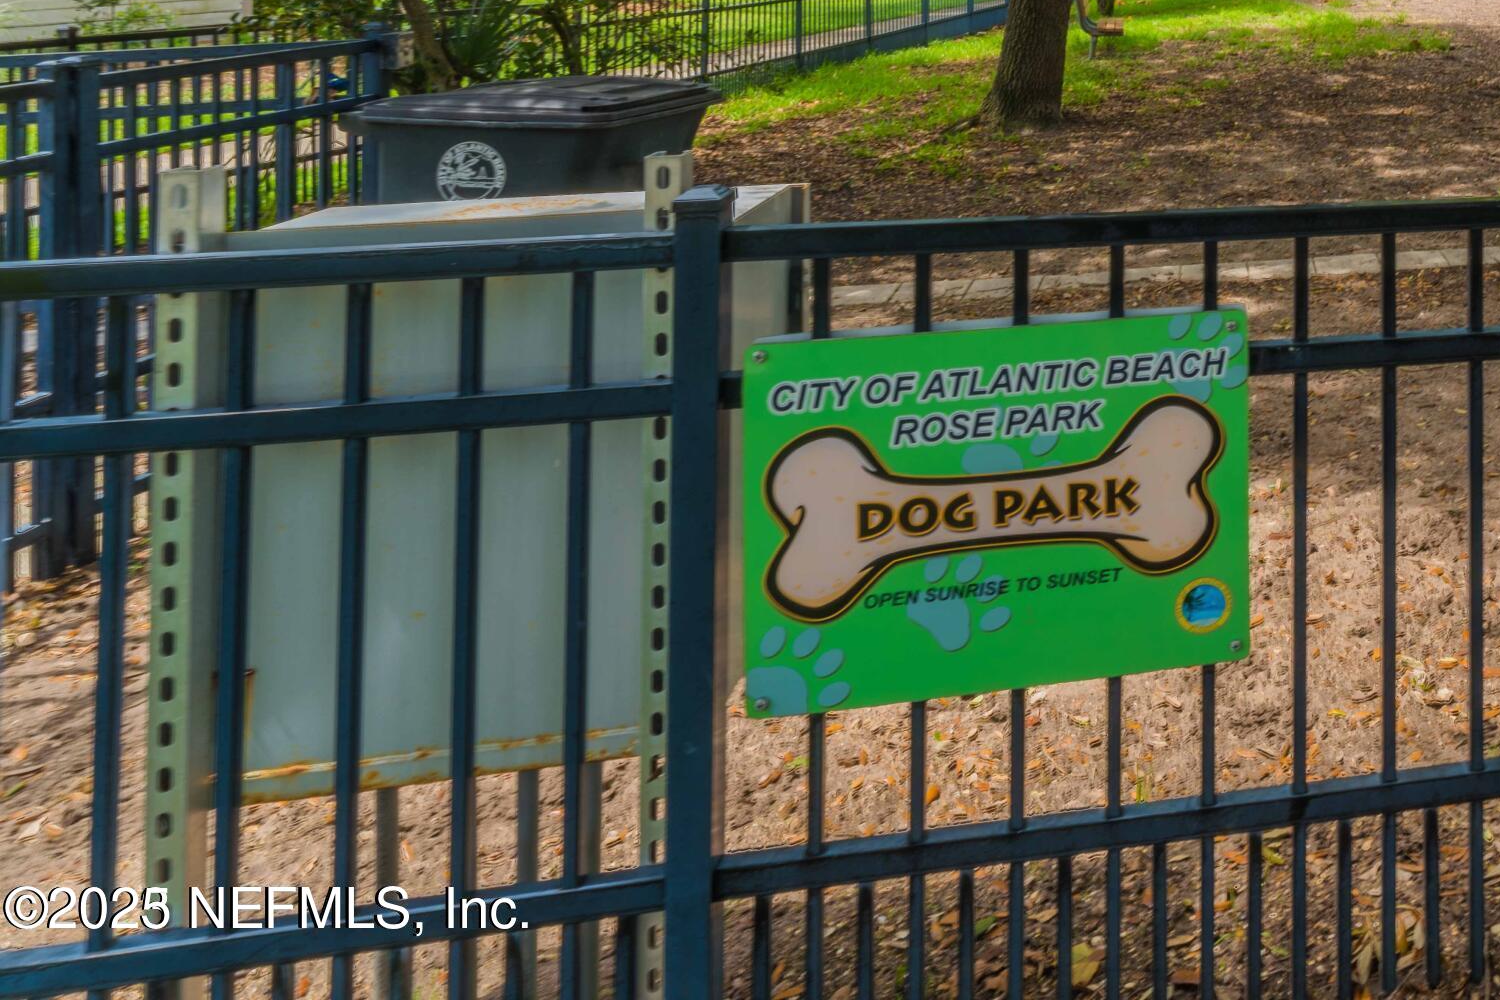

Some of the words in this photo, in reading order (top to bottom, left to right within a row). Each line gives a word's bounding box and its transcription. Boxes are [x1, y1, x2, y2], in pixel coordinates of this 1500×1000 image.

[770, 377, 858, 413] CITY
[863, 374, 918, 405] OF
[919, 360, 1099, 401] ATLANTIC
[1104, 349, 1228, 386] BEACH
[892, 409, 997, 447] ROSE
[1003, 400, 1105, 436] PARK
[856, 492, 978, 542] DOG
[992, 476, 1141, 529] PARK
[863, 590, 919, 609] OPEN
[923, 579, 1010, 602] SUNRISE
[1016, 575, 1042, 593] TO
[1045, 567, 1124, 589] SUNSET
